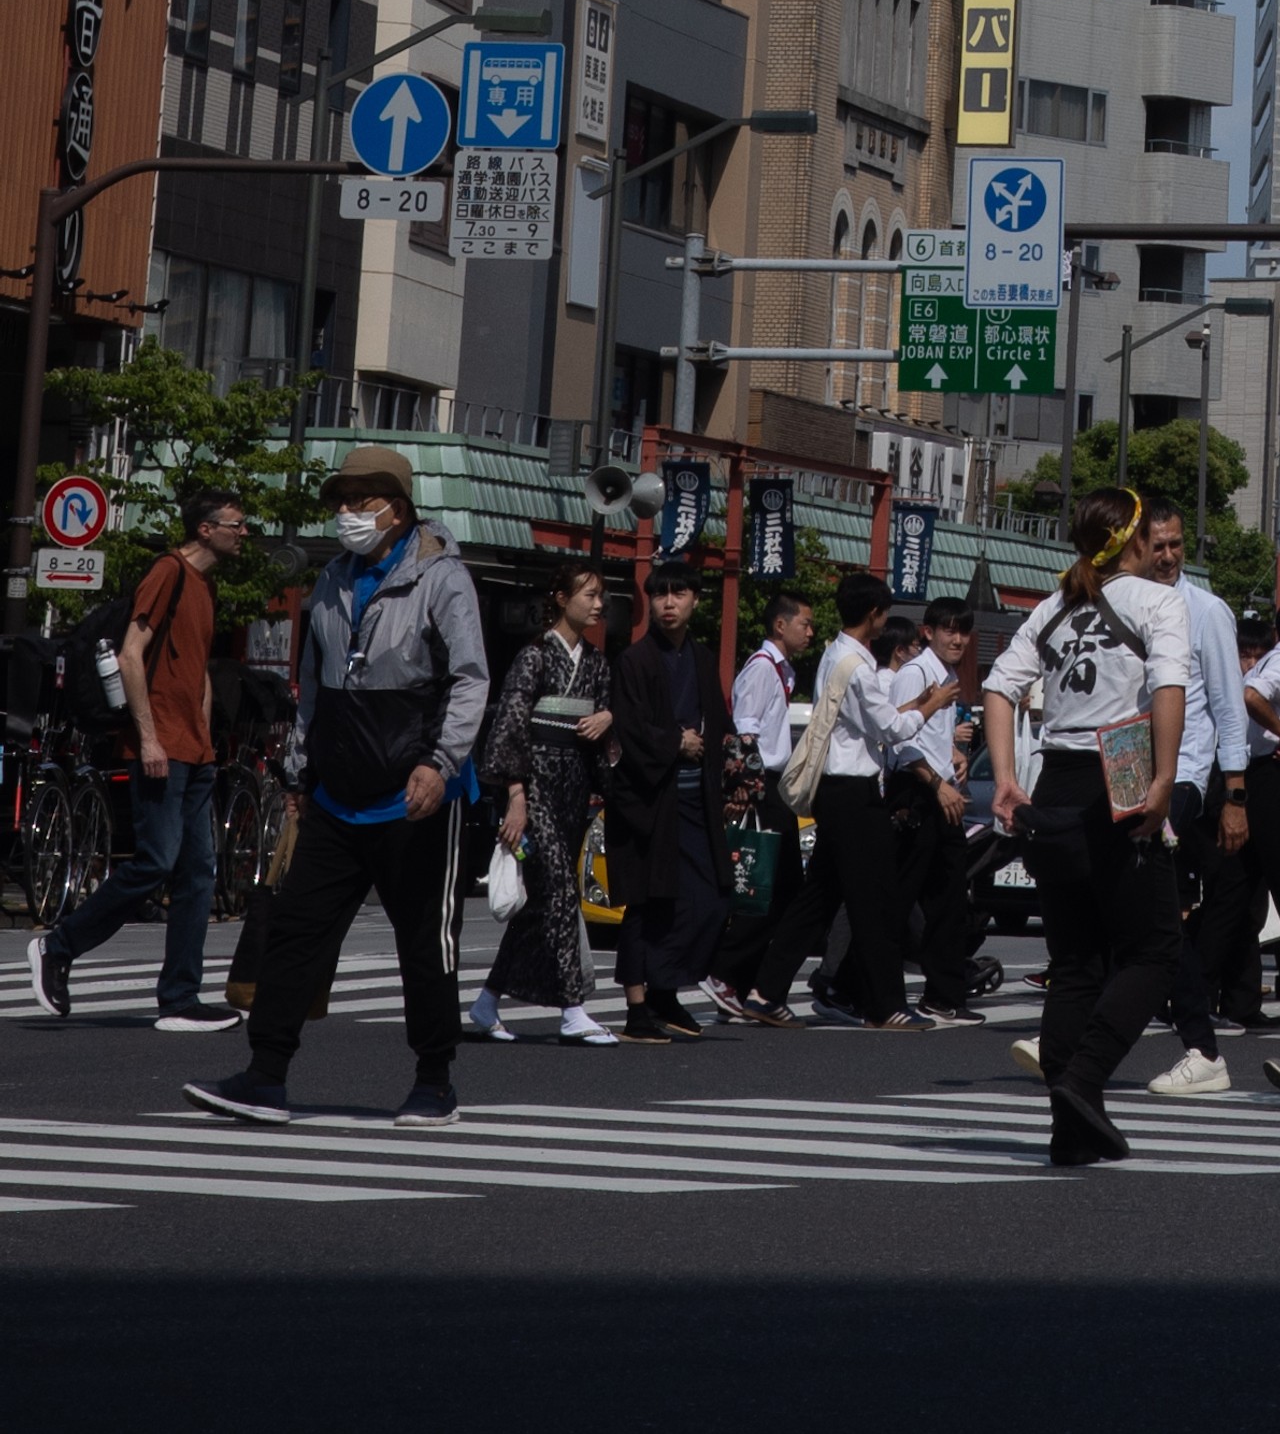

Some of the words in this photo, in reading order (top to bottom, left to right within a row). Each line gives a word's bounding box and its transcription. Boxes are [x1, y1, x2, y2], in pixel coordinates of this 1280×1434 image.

[486, 86, 536, 107] 専用
[466, 155, 545, 171] 路線バス
[456, 186, 550, 201] 通勤送迎バス
[461, 241, 539, 255] ここまで
[915, 239, 926, 256] 6
[973, 284, 1054, 301] この先吾妻橋交差点
[913, 303, 934, 317] E6
[908, 324, 969, 344] 常磐道
[984, 325, 1051, 345] 都心環状
[901, 345, 944, 361] JOBAN
[949, 345, 973, 361] EXP
[986, 347, 1031, 361] Circle
[1038, 347, 1047, 361] 1
[762, 512, 784, 574] 三社祭
[902, 536, 920, 593] 三社祭
